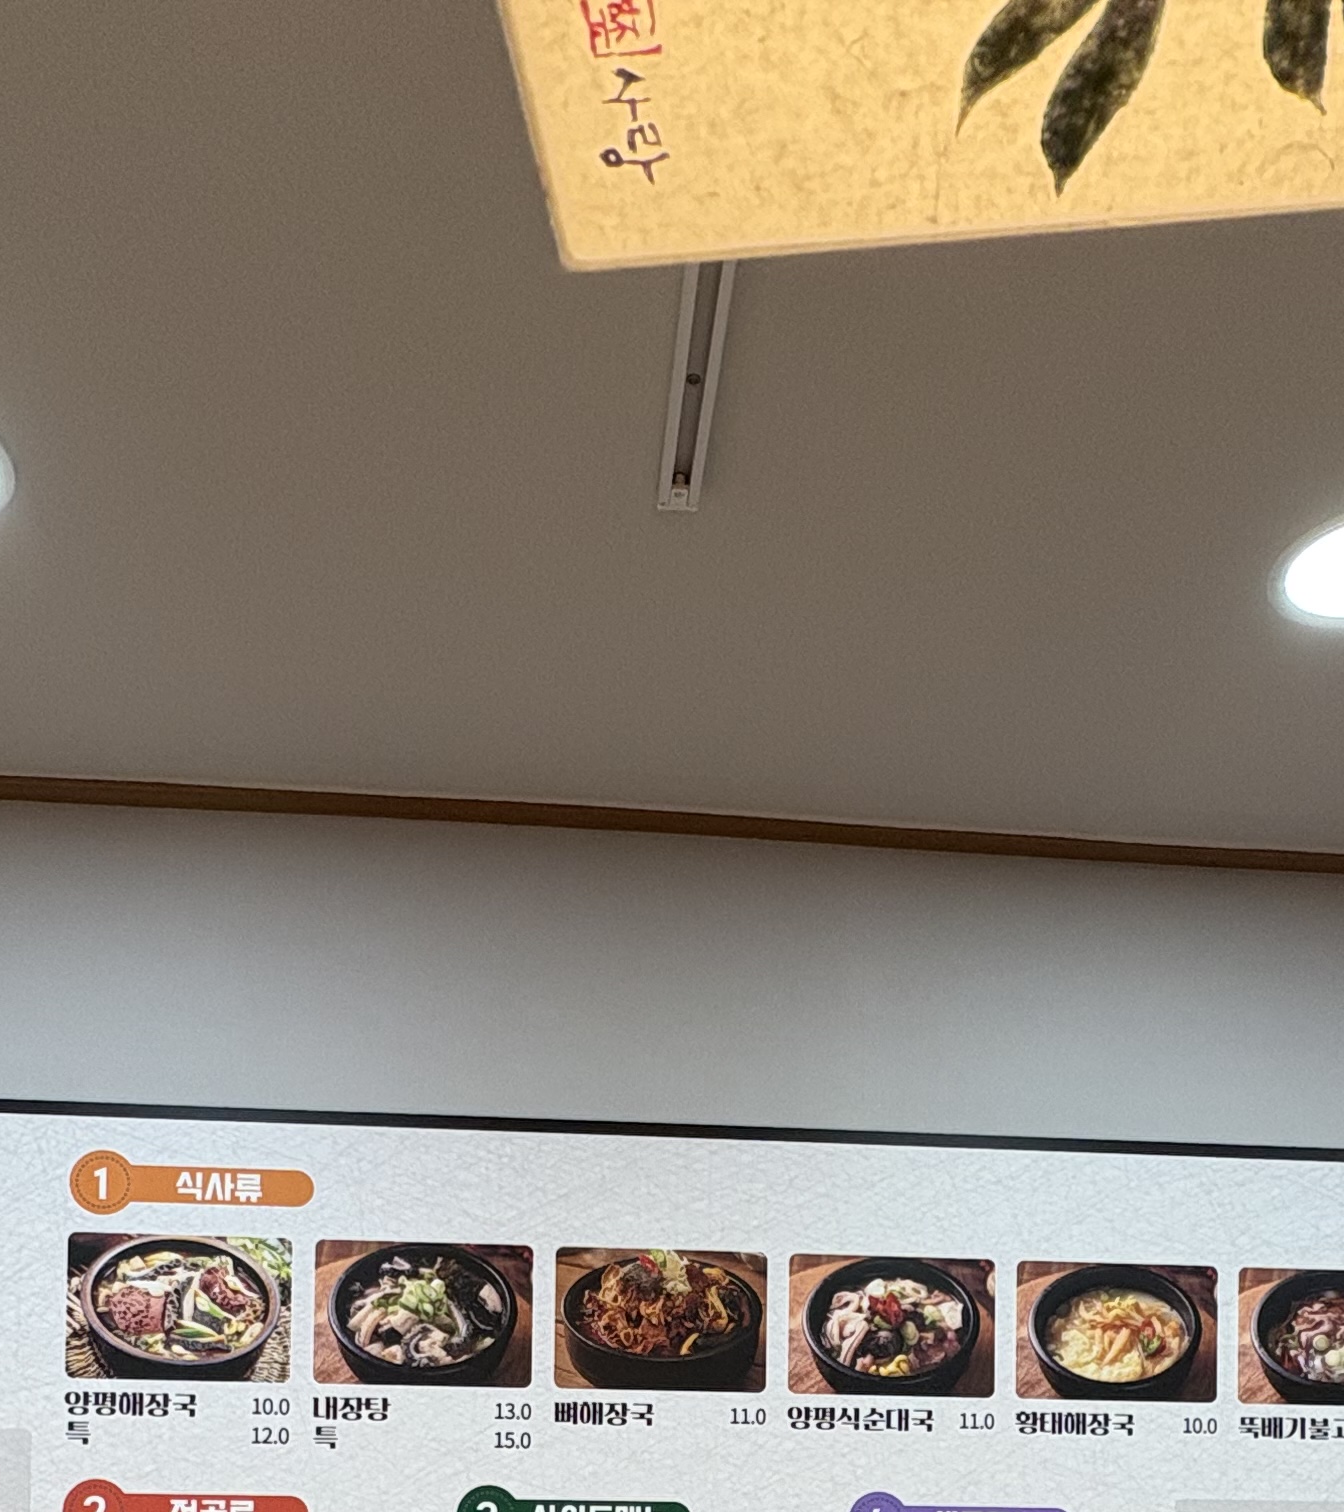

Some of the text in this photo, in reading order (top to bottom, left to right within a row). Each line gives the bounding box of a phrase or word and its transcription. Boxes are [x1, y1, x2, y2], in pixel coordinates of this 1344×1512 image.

[599, 67, 670, 186] 사랑
[93, 1166, 263, 1203] 1 식사류
[64, 1391, 291, 1418] 양평해장국 10.0
[312, 1396, 532, 1422] 내장탕 13.0
[554, 1401, 767, 1427] 뼈해장국 11.0
[65, 1421, 290, 1445] 특 12.0
[787, 1406, 995, 1433] 양평식순대국 11.0
[1015, 1410, 1218, 1437] 황태해장국 10.0
[313, 1426, 532, 1450] 특 15.0
